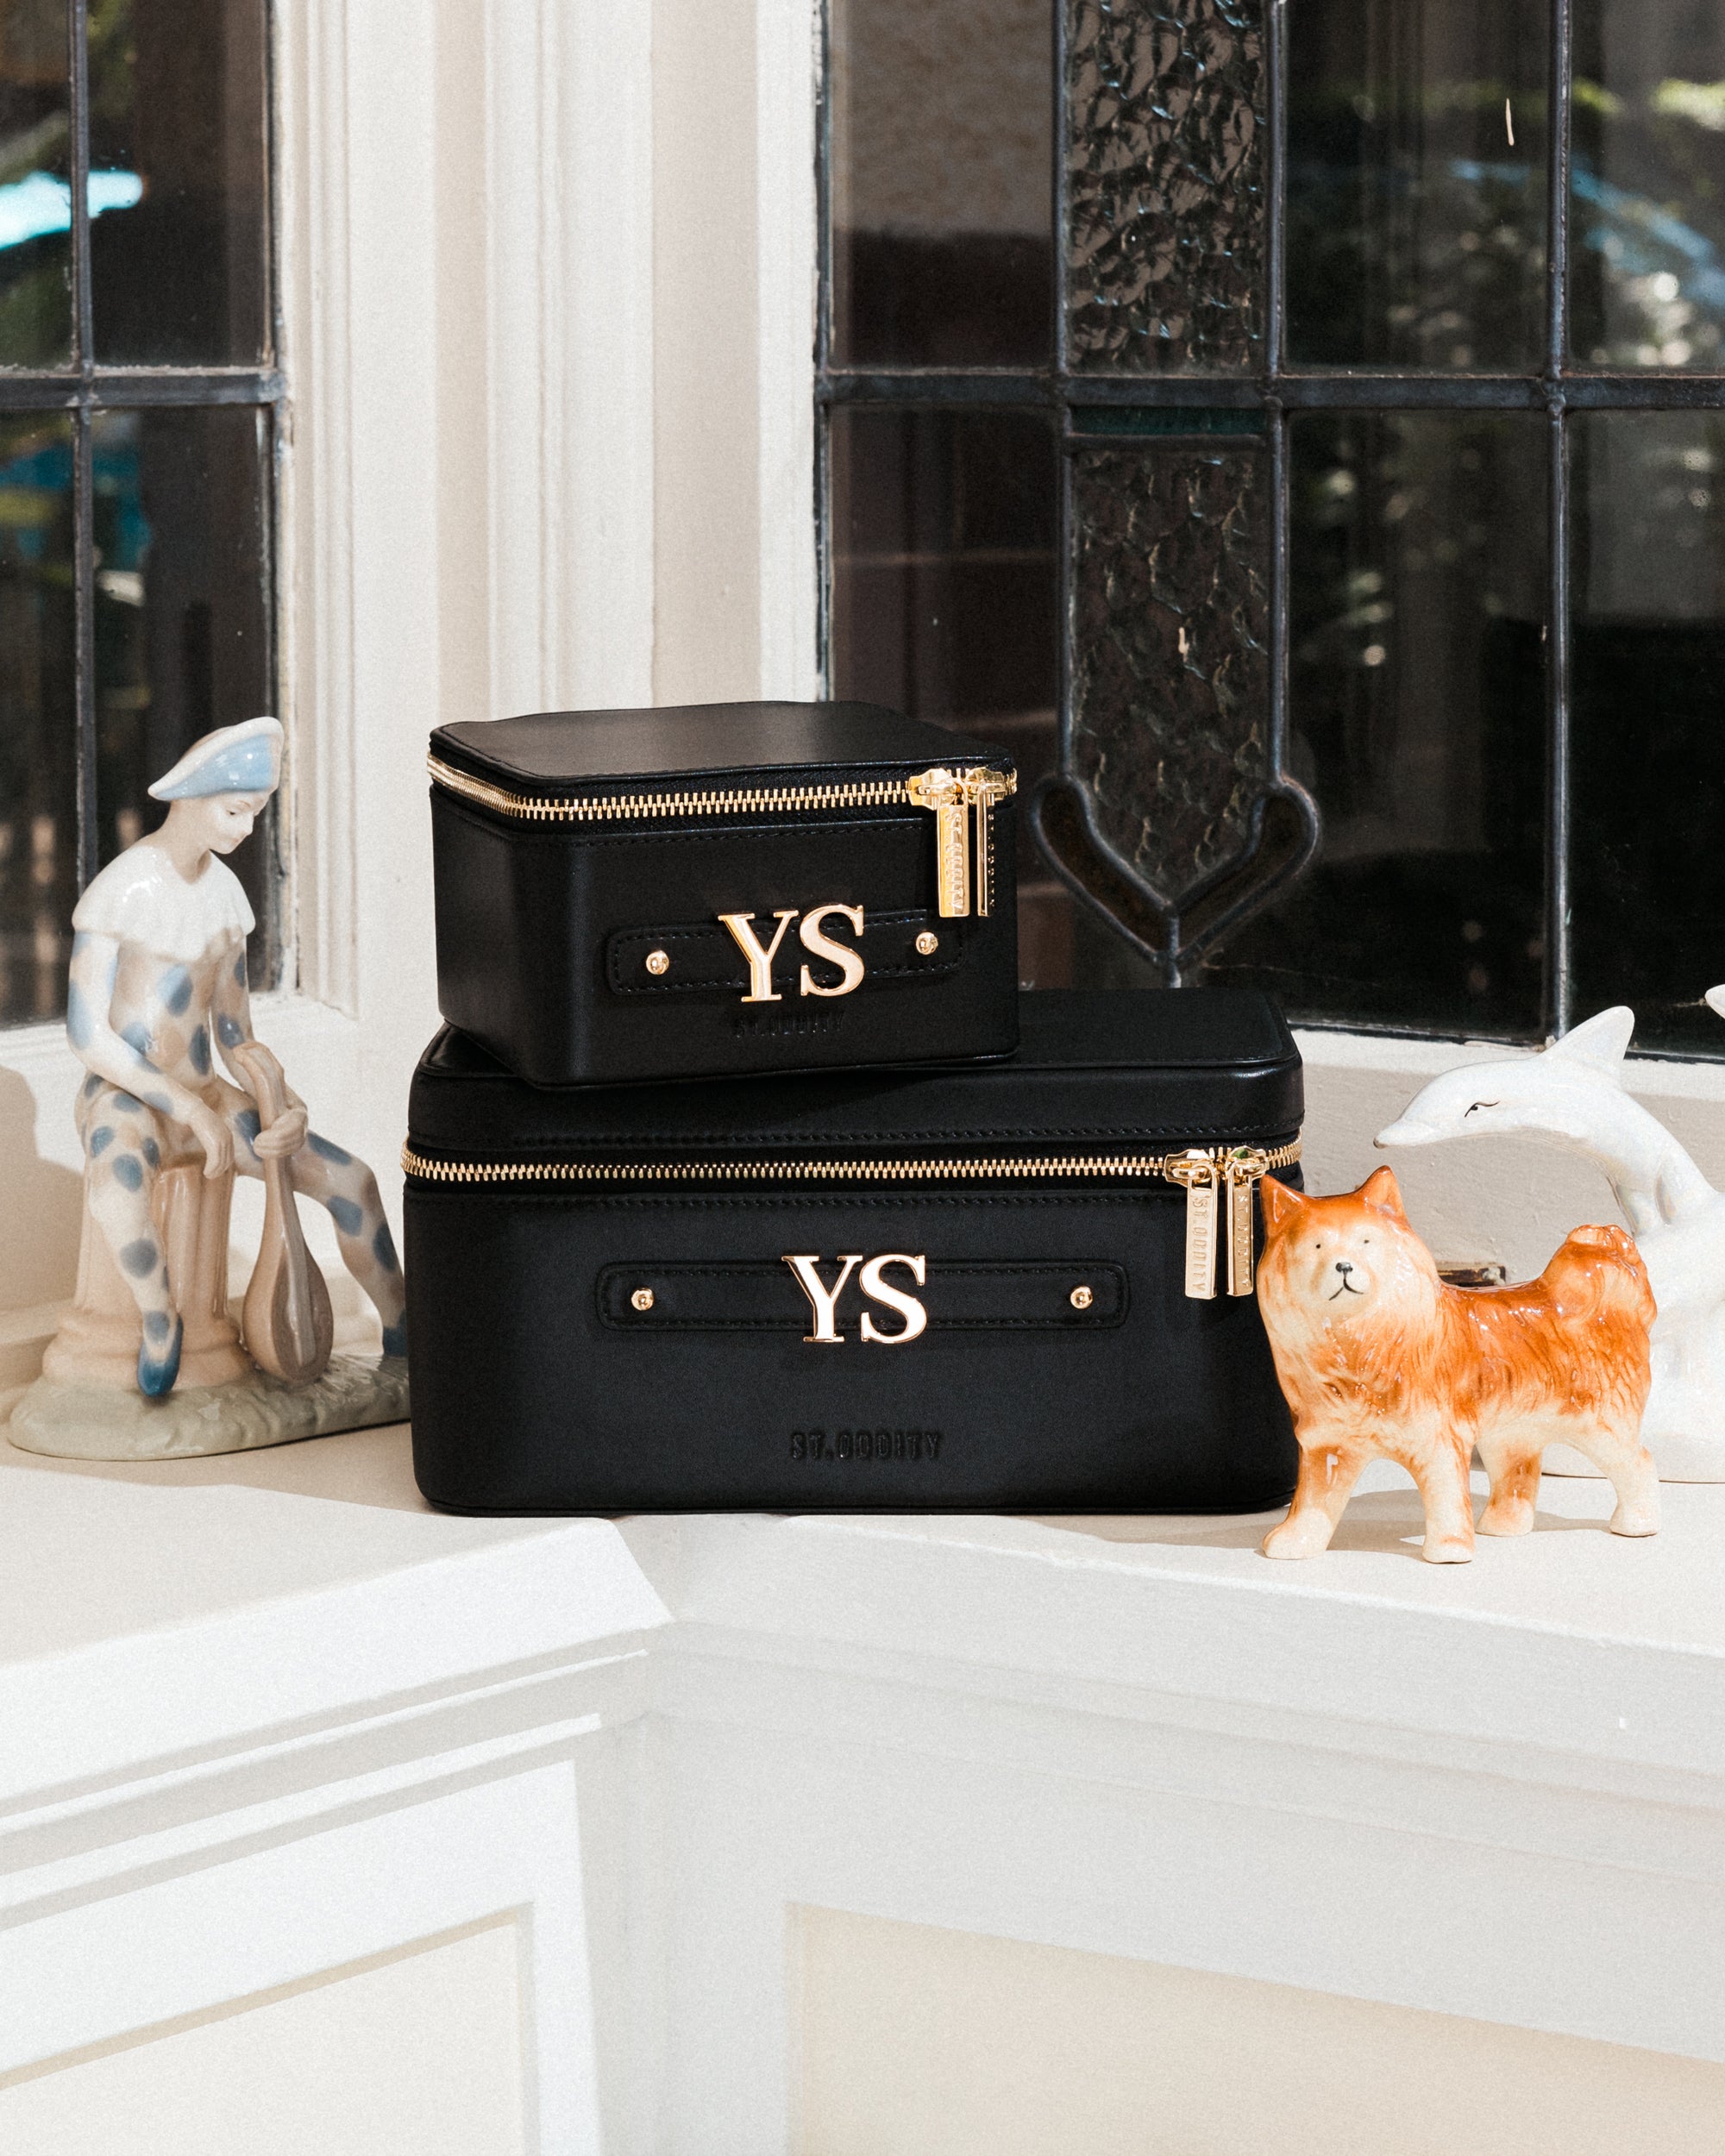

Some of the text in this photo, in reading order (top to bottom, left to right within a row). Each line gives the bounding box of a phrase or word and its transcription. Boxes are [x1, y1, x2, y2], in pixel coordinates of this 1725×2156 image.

[718, 904, 865, 1002] YS
[1192, 1196, 1208, 1292] ST.ODDITY
[781, 1254, 927, 1344] YS
[791, 1432, 942, 1460] ST.ODDITY
